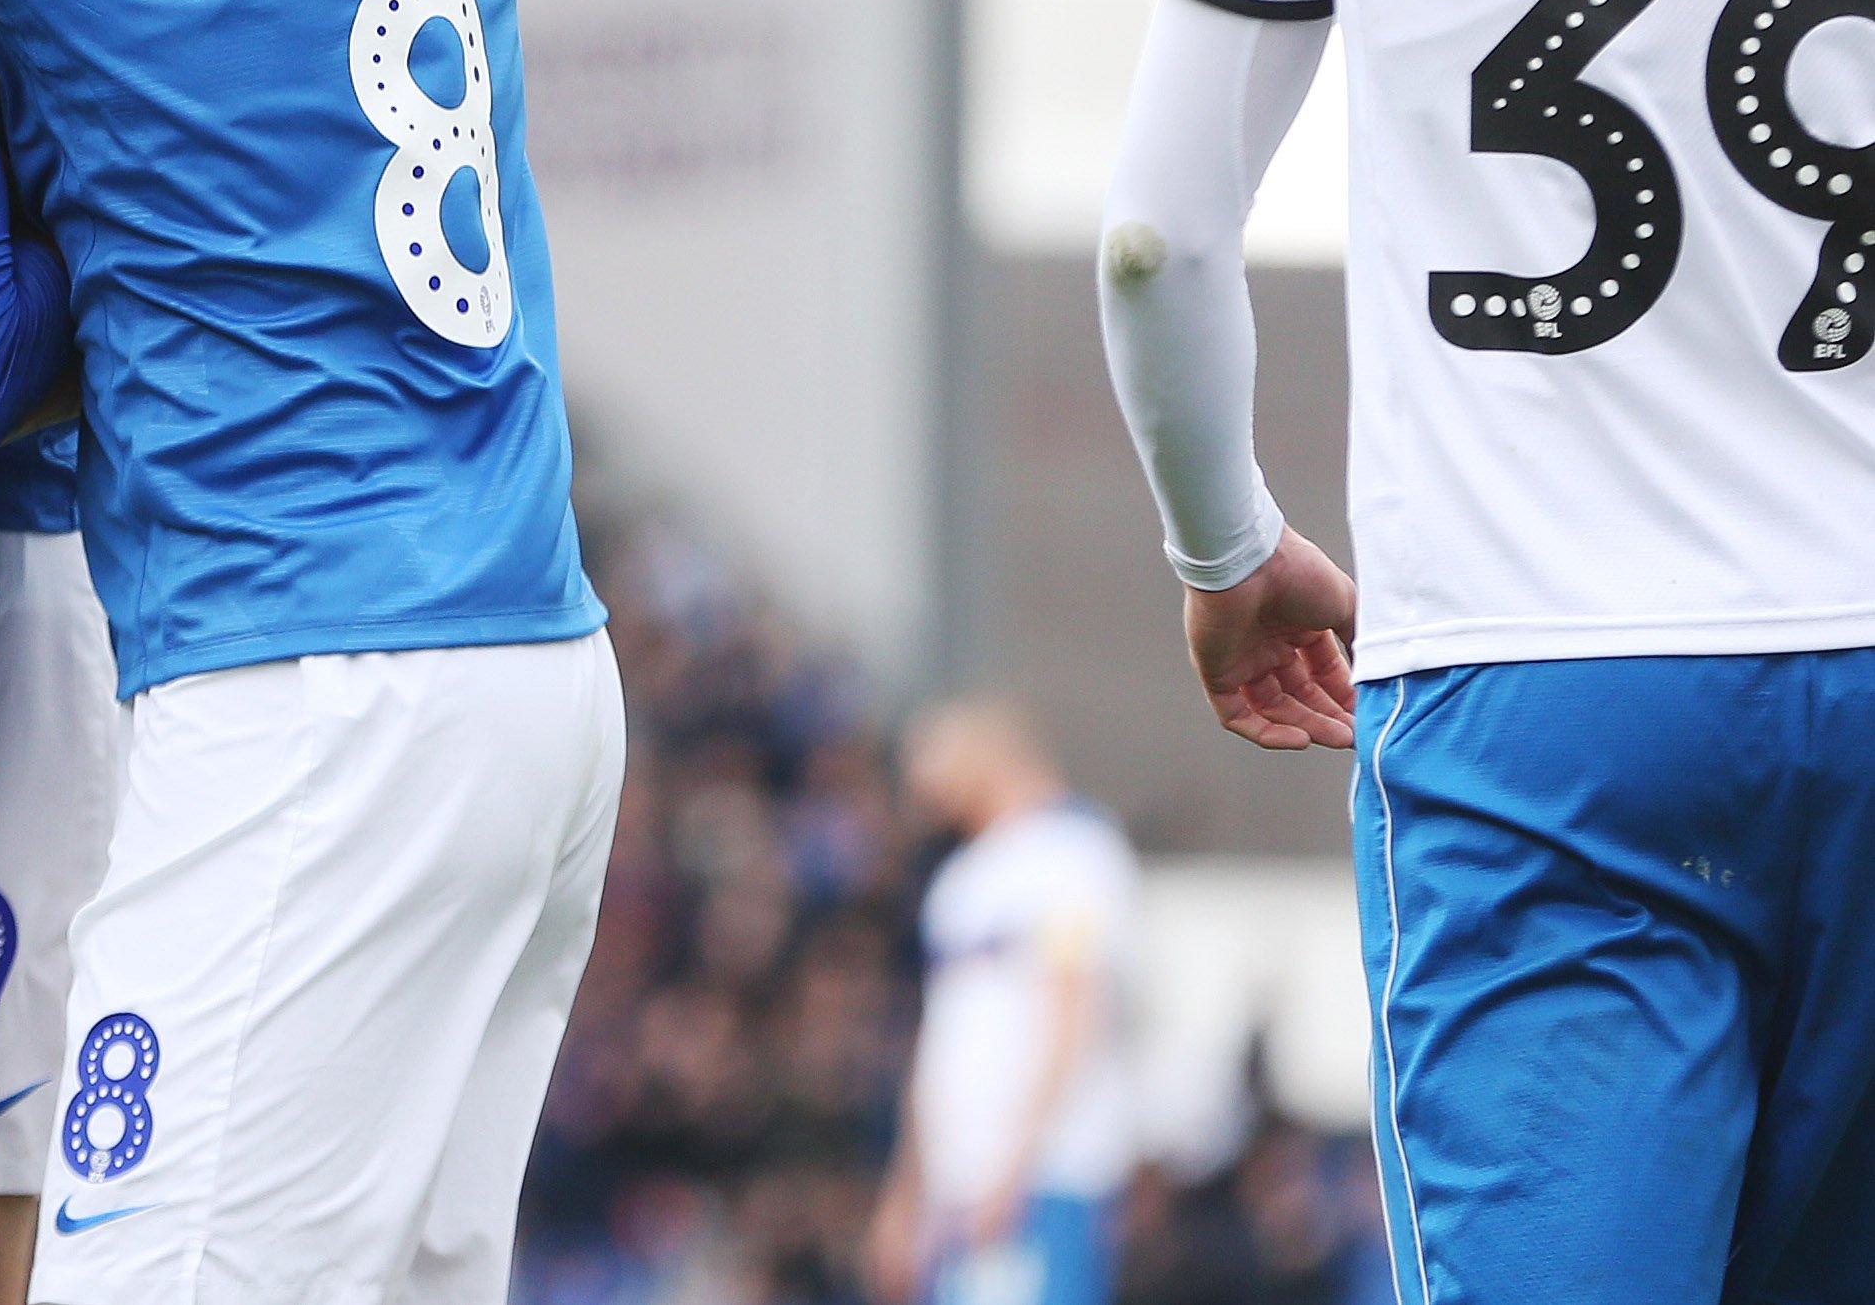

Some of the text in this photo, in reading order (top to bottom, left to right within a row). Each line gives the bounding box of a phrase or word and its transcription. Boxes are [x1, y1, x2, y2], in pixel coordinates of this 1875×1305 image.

[1533, 321, 1563, 339] EFL
[1813, 343, 1847, 360] EFL
[62, 1011, 161, 1184] 8
